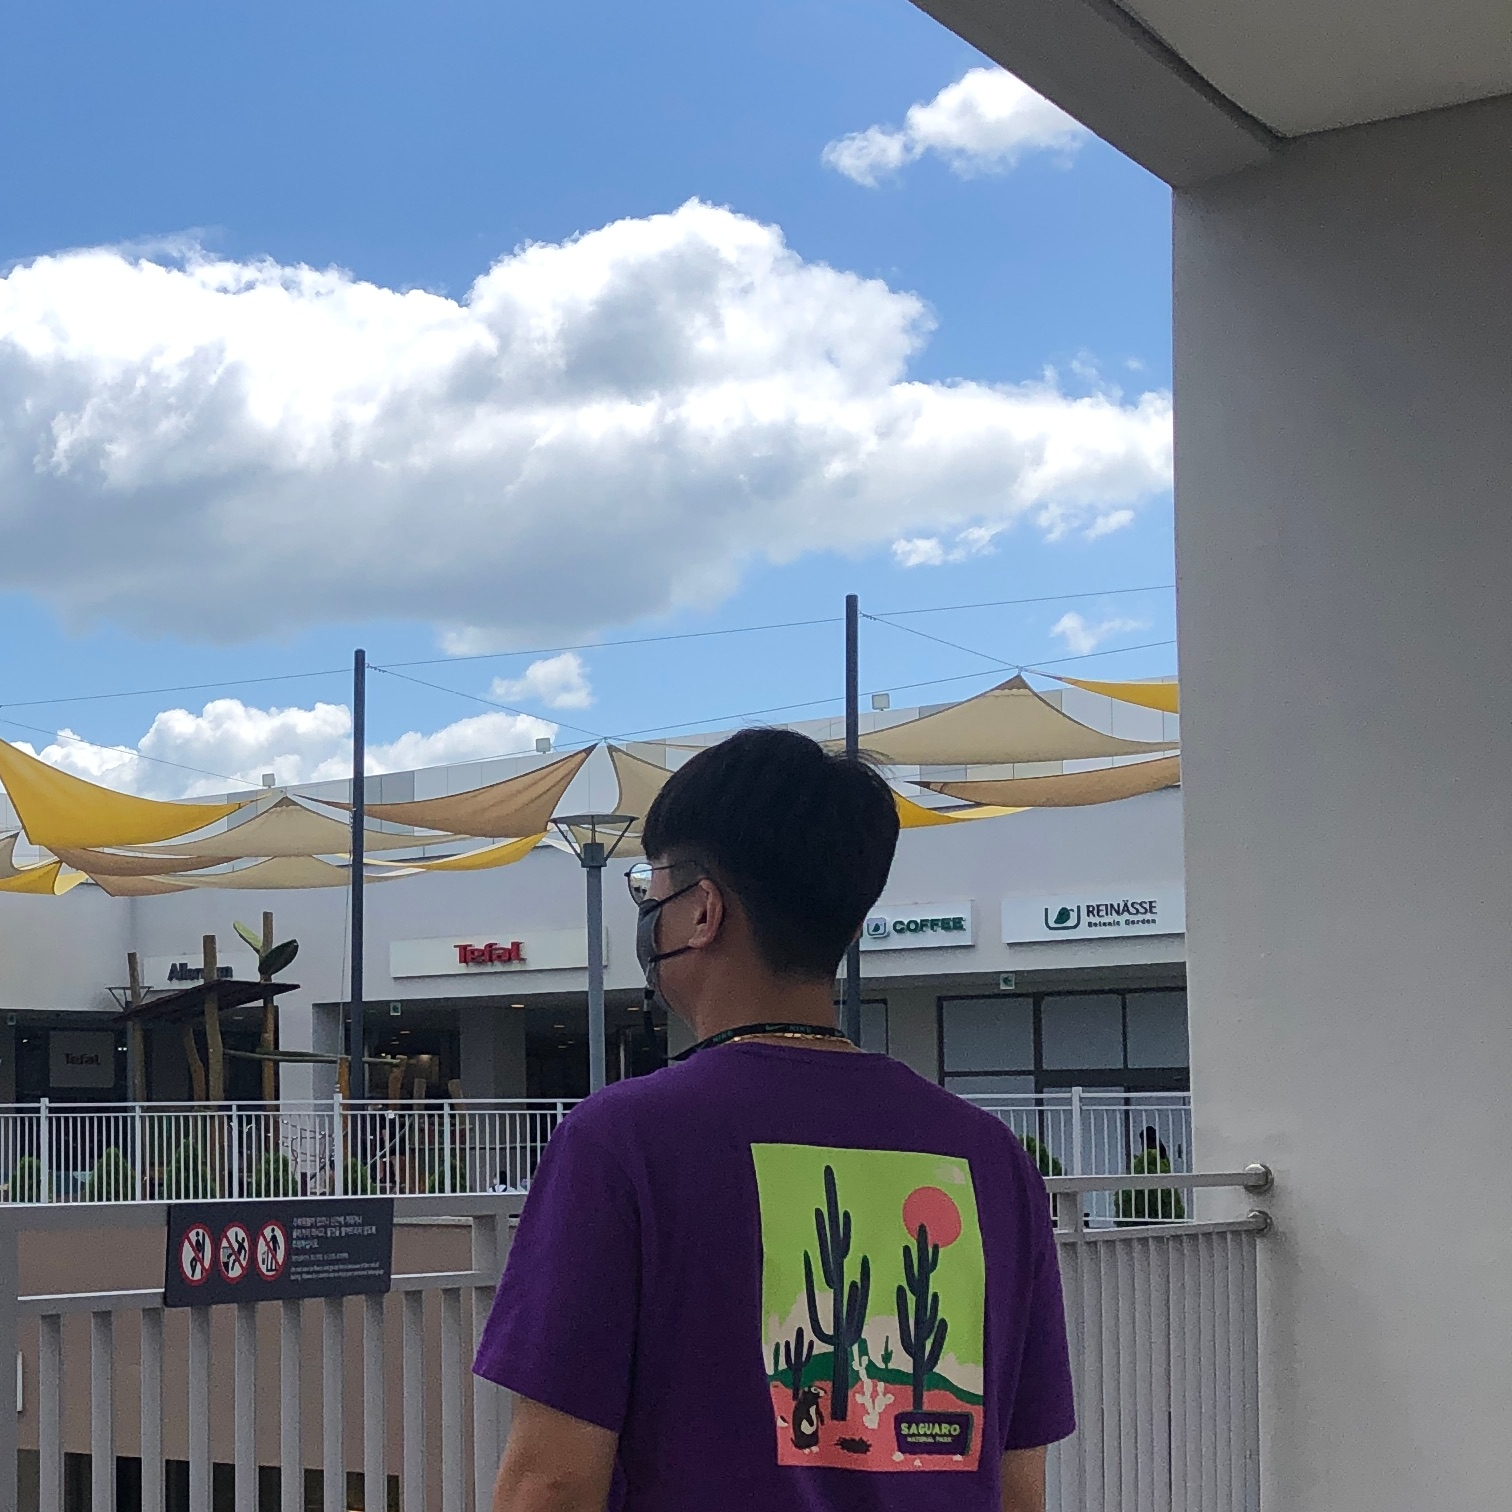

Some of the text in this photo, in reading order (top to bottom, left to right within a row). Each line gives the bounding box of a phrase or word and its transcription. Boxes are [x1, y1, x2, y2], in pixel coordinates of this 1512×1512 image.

[1085, 899, 1158, 918] REINÄSSE
[892, 917, 966, 934] COFFEE
[453, 941, 526, 964] Tefal
[900, 1422, 960, 1436] SAGUARO
